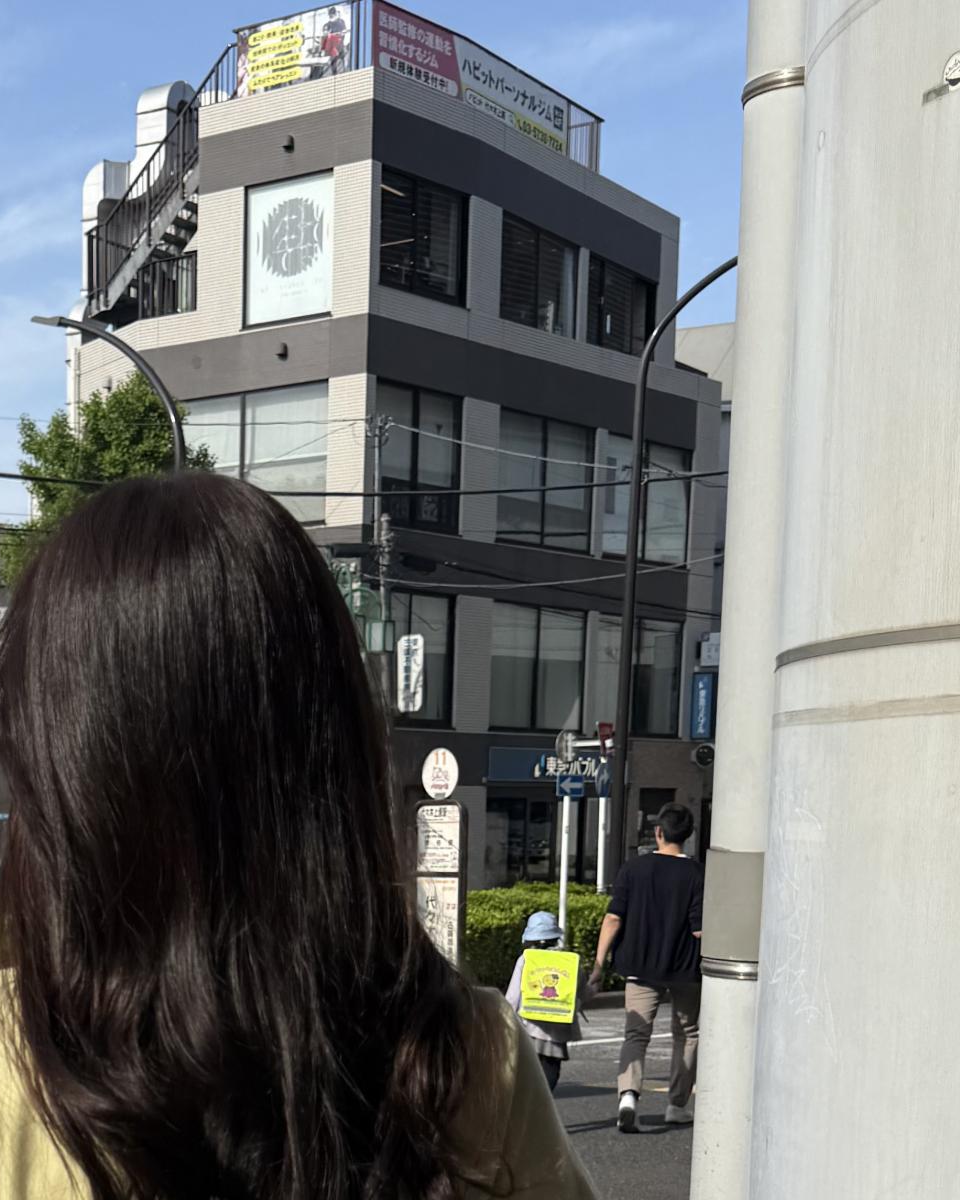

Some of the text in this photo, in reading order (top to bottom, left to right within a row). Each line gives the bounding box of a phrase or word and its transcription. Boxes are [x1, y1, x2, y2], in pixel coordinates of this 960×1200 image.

[378, 10, 452, 56] 医師監修の運動を
[378, 30, 439, 69] 習慣化するジム
[462, 59, 553, 122] ハビットパーソナルジム
